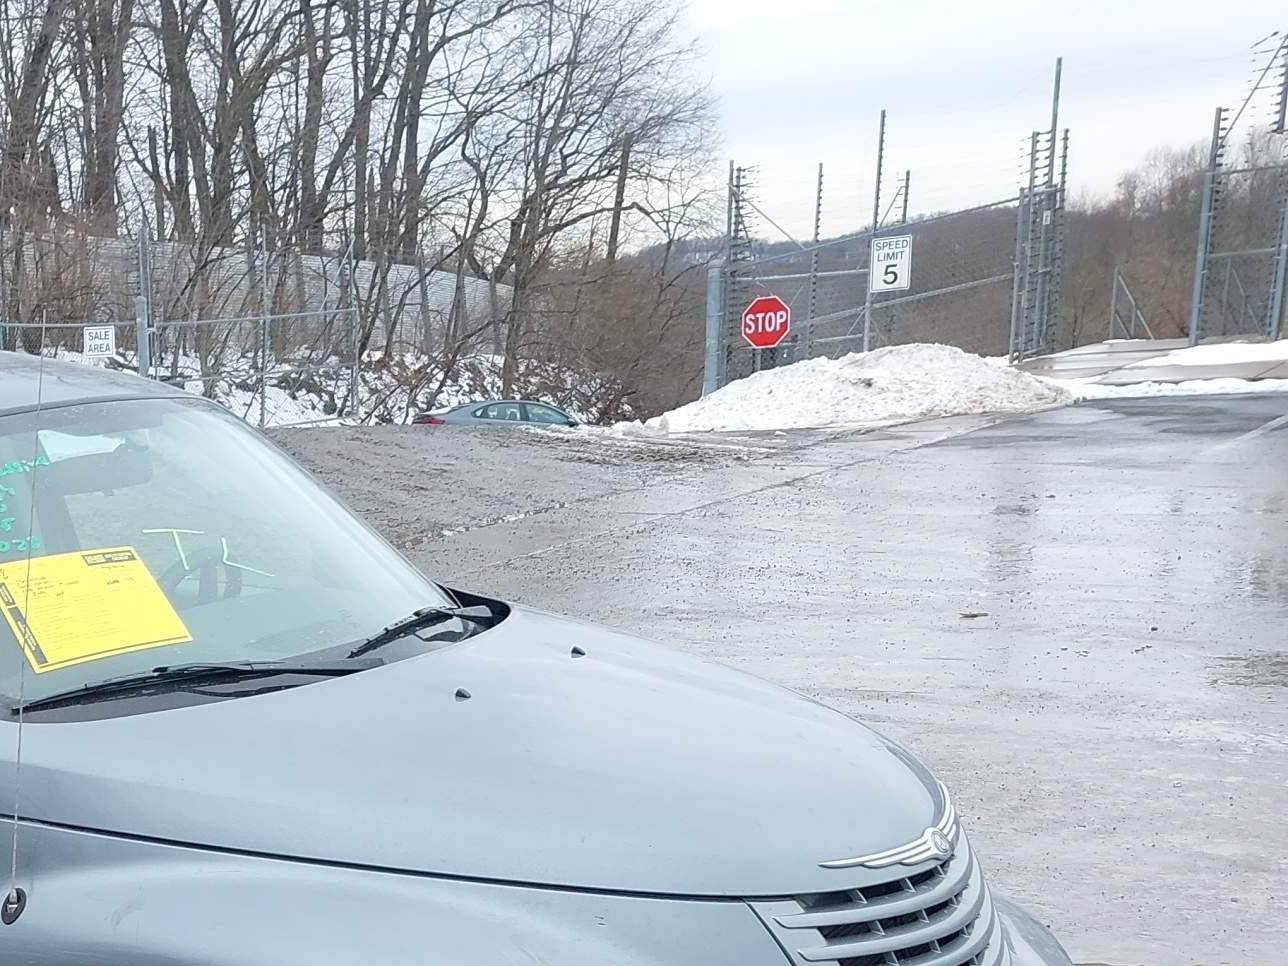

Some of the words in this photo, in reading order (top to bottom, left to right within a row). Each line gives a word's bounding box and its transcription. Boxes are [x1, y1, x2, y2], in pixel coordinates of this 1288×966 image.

[875, 239, 908, 252] SPEED
[877, 251, 905, 262] LIMIT
[883, 264, 898, 285] 5
[745, 310, 787, 335] STOP
[88, 330, 110, 341] SALE
[87, 342, 111, 353] AREA
